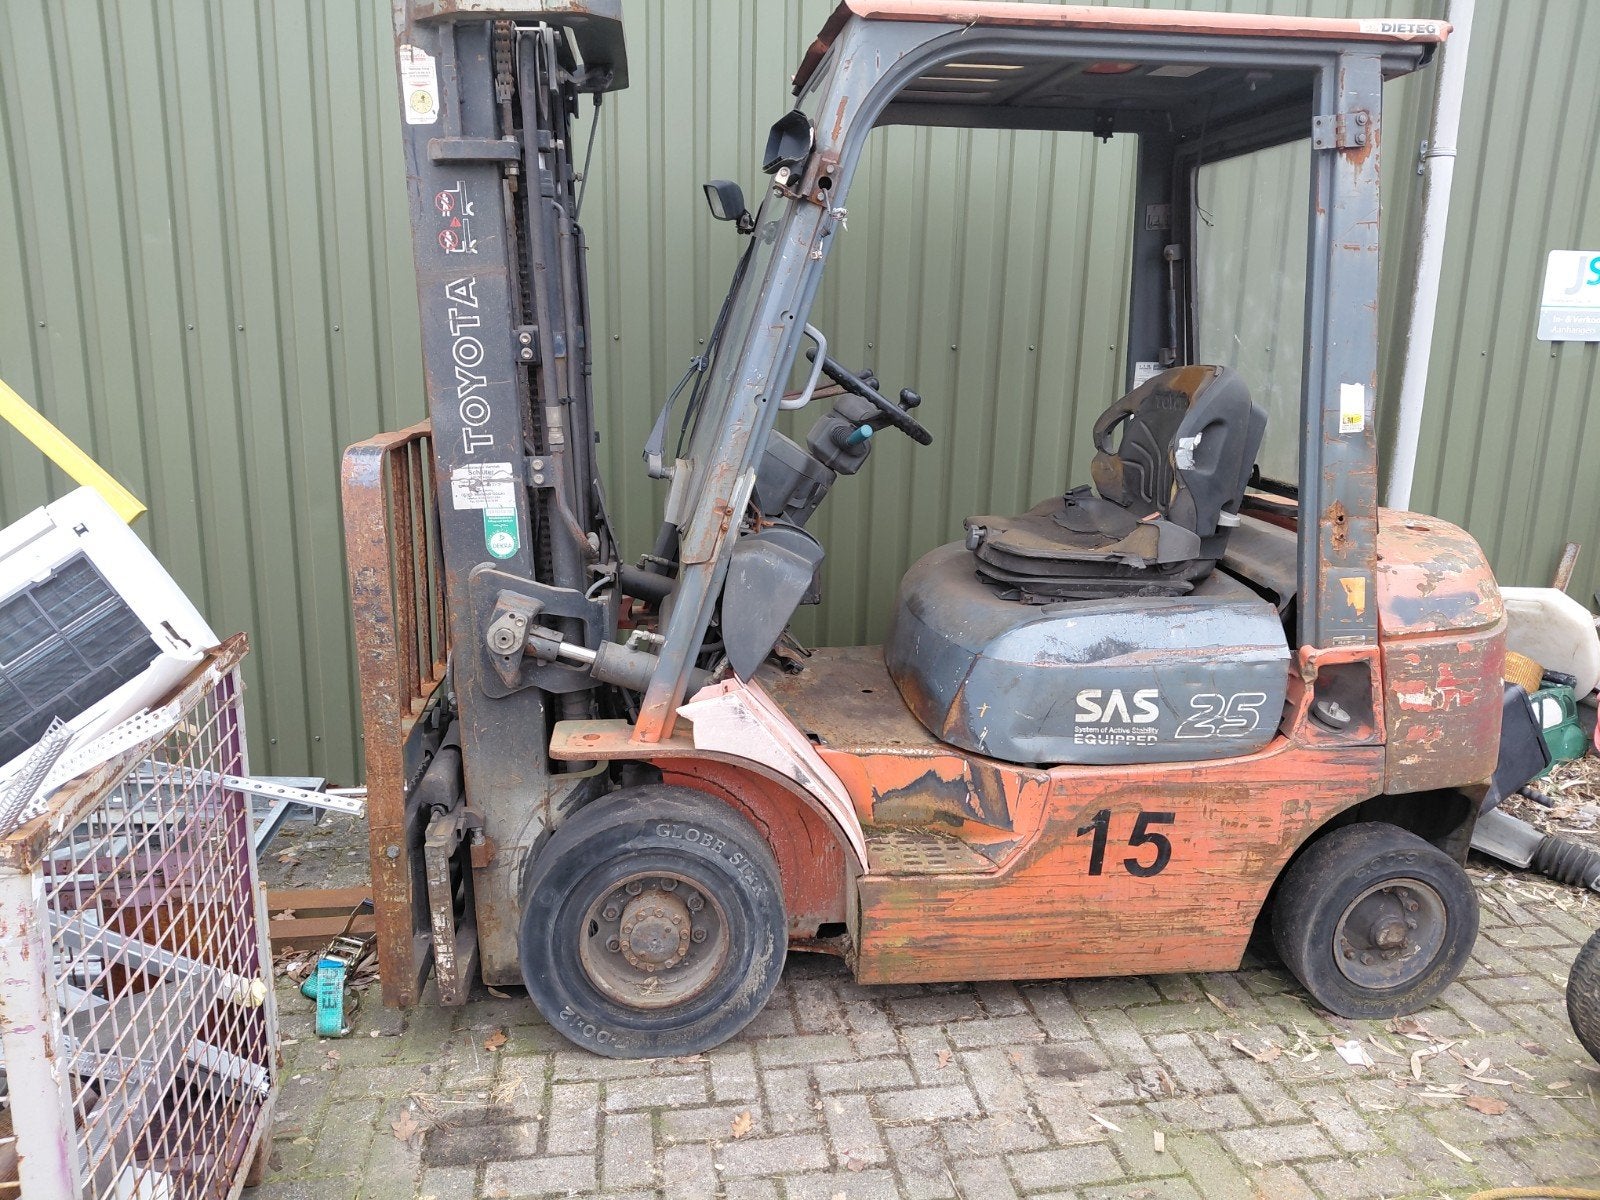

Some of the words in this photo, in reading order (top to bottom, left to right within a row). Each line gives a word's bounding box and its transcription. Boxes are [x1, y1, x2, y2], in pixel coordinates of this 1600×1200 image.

[1381, 23, 1436, 34] DIETEG
[446, 277, 494, 454] TOYOTA
[1074, 689, 1159, 724] SAS
[1174, 692, 1267, 739] 25
[1074, 726, 1099, 734] System
[1131, 727, 1160, 735] Stability
[1074, 733, 1158, 746] EQUIPPED
[655, 823, 727, 854] GLOBE
[1076, 808, 1176, 878] 15
